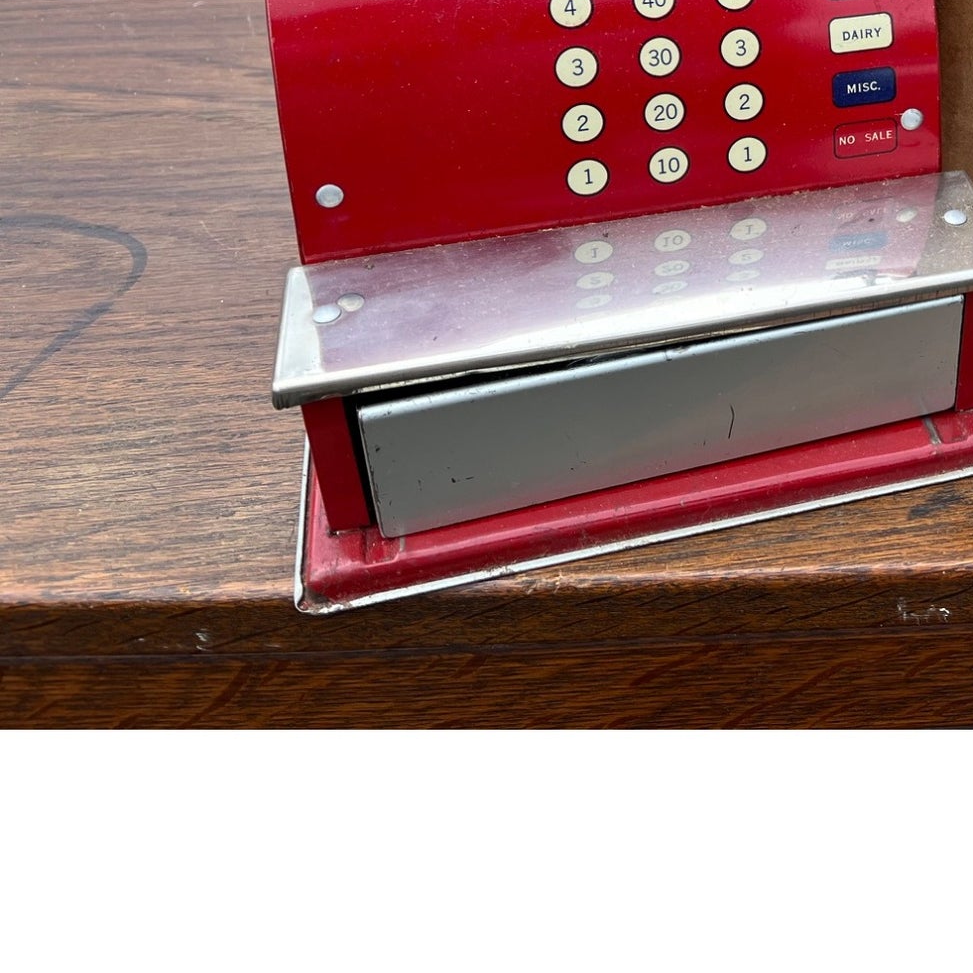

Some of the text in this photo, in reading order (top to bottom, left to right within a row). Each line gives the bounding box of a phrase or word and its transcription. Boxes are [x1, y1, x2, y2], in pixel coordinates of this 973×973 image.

[842, 27, 882, 42] DAIRY
[735, 39, 747, 56] 3
[648, 48, 673, 67] 30
[571, 58, 584, 76] 3
[846, 81, 881, 95] MISC.
[739, 93, 751, 111] 2
[653, 103, 678, 122] 20
[577, 114, 590, 132] 2
[839, 130, 893, 146] NO SALE
[743, 146, 753, 163] 1
[658, 156, 681, 175] 10
[584, 168, 594, 185] 1
